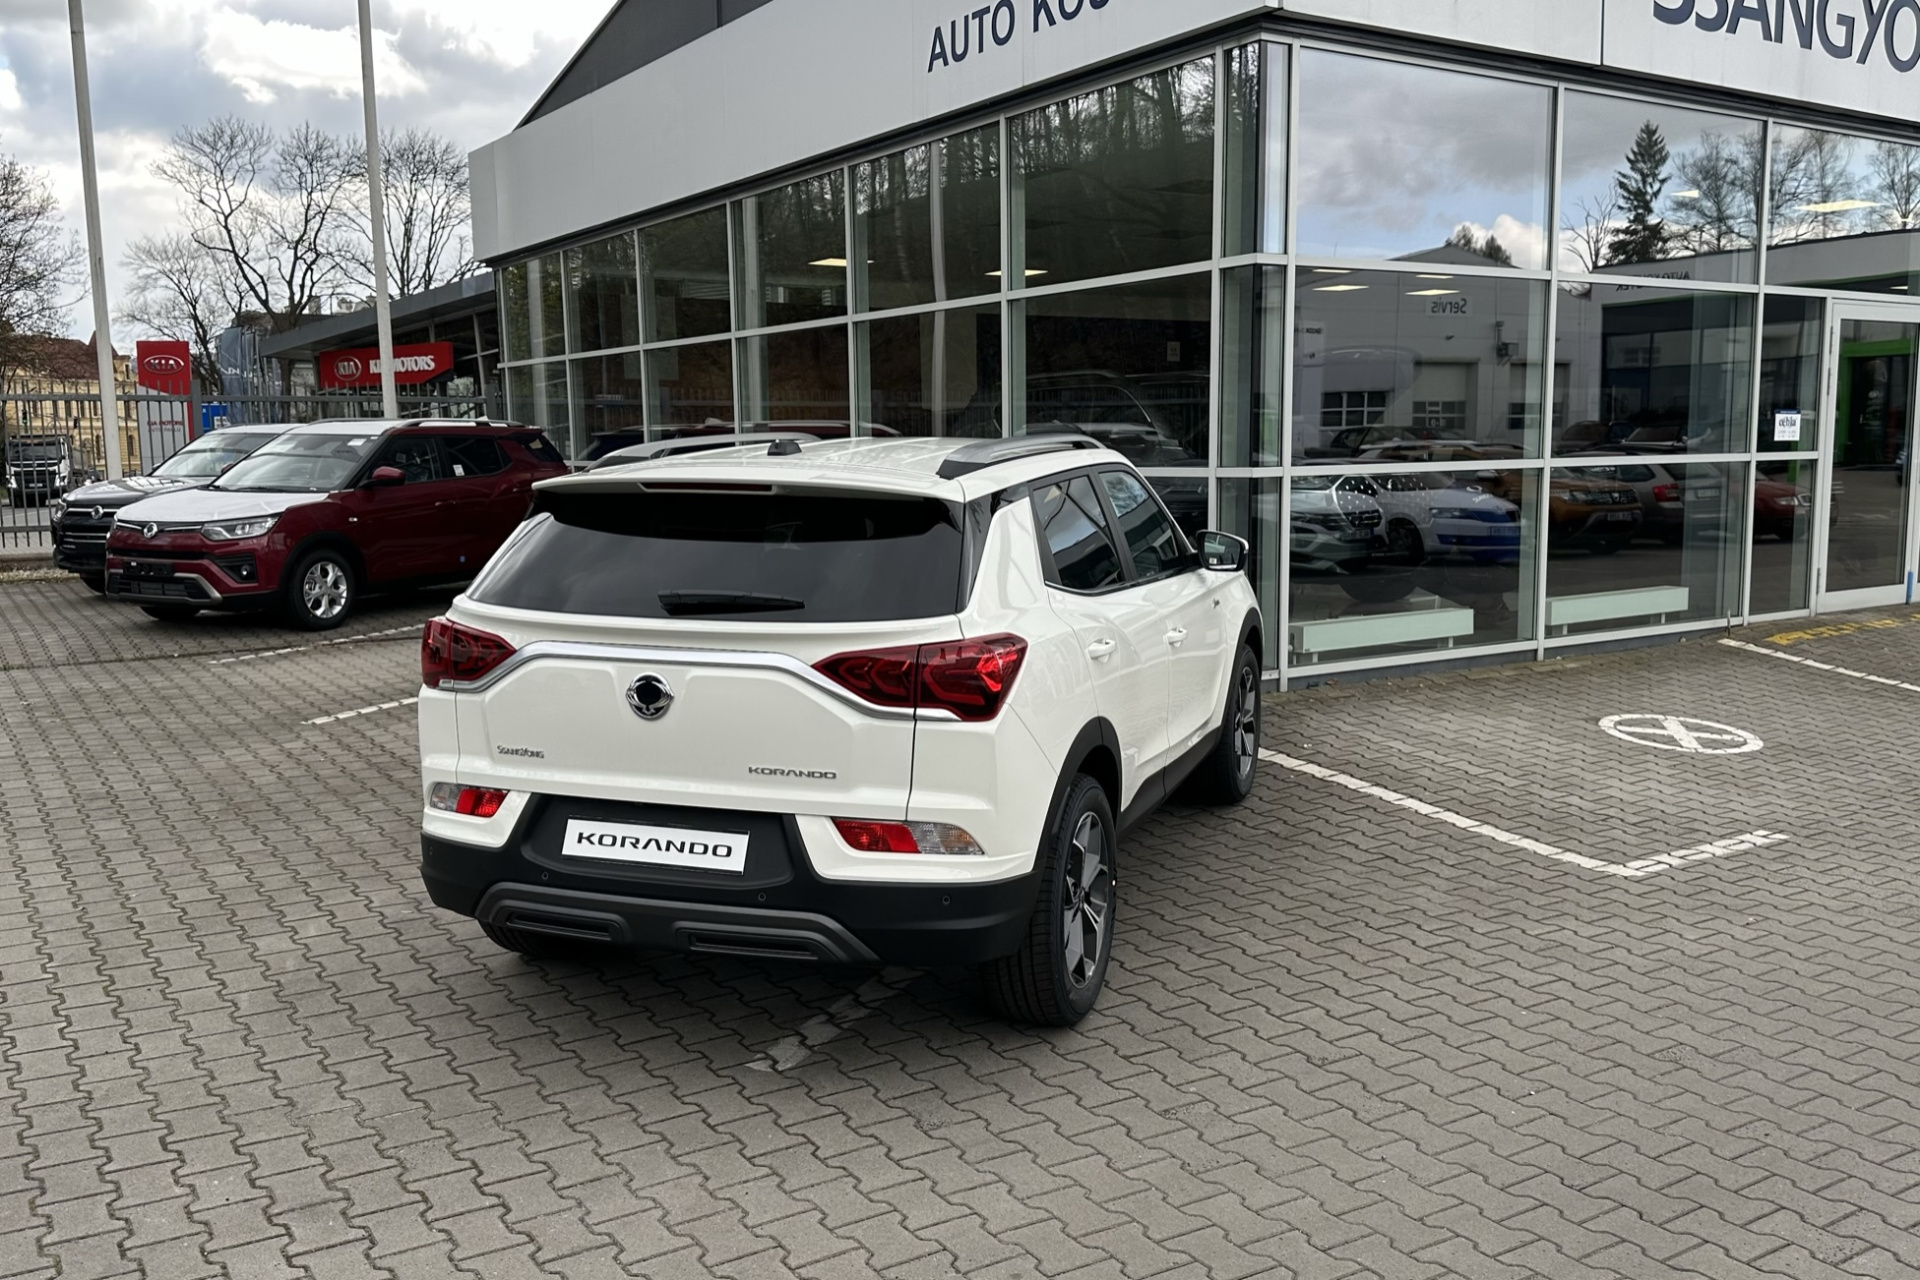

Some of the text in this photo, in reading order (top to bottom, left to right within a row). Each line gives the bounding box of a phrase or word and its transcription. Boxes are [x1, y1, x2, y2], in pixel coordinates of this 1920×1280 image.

[928, 0, 1015, 73] AUTO
[369, 359, 382, 374] KI
[748, 766, 837, 780] KORANDO
[577, 832, 733, 858] KORANDO
